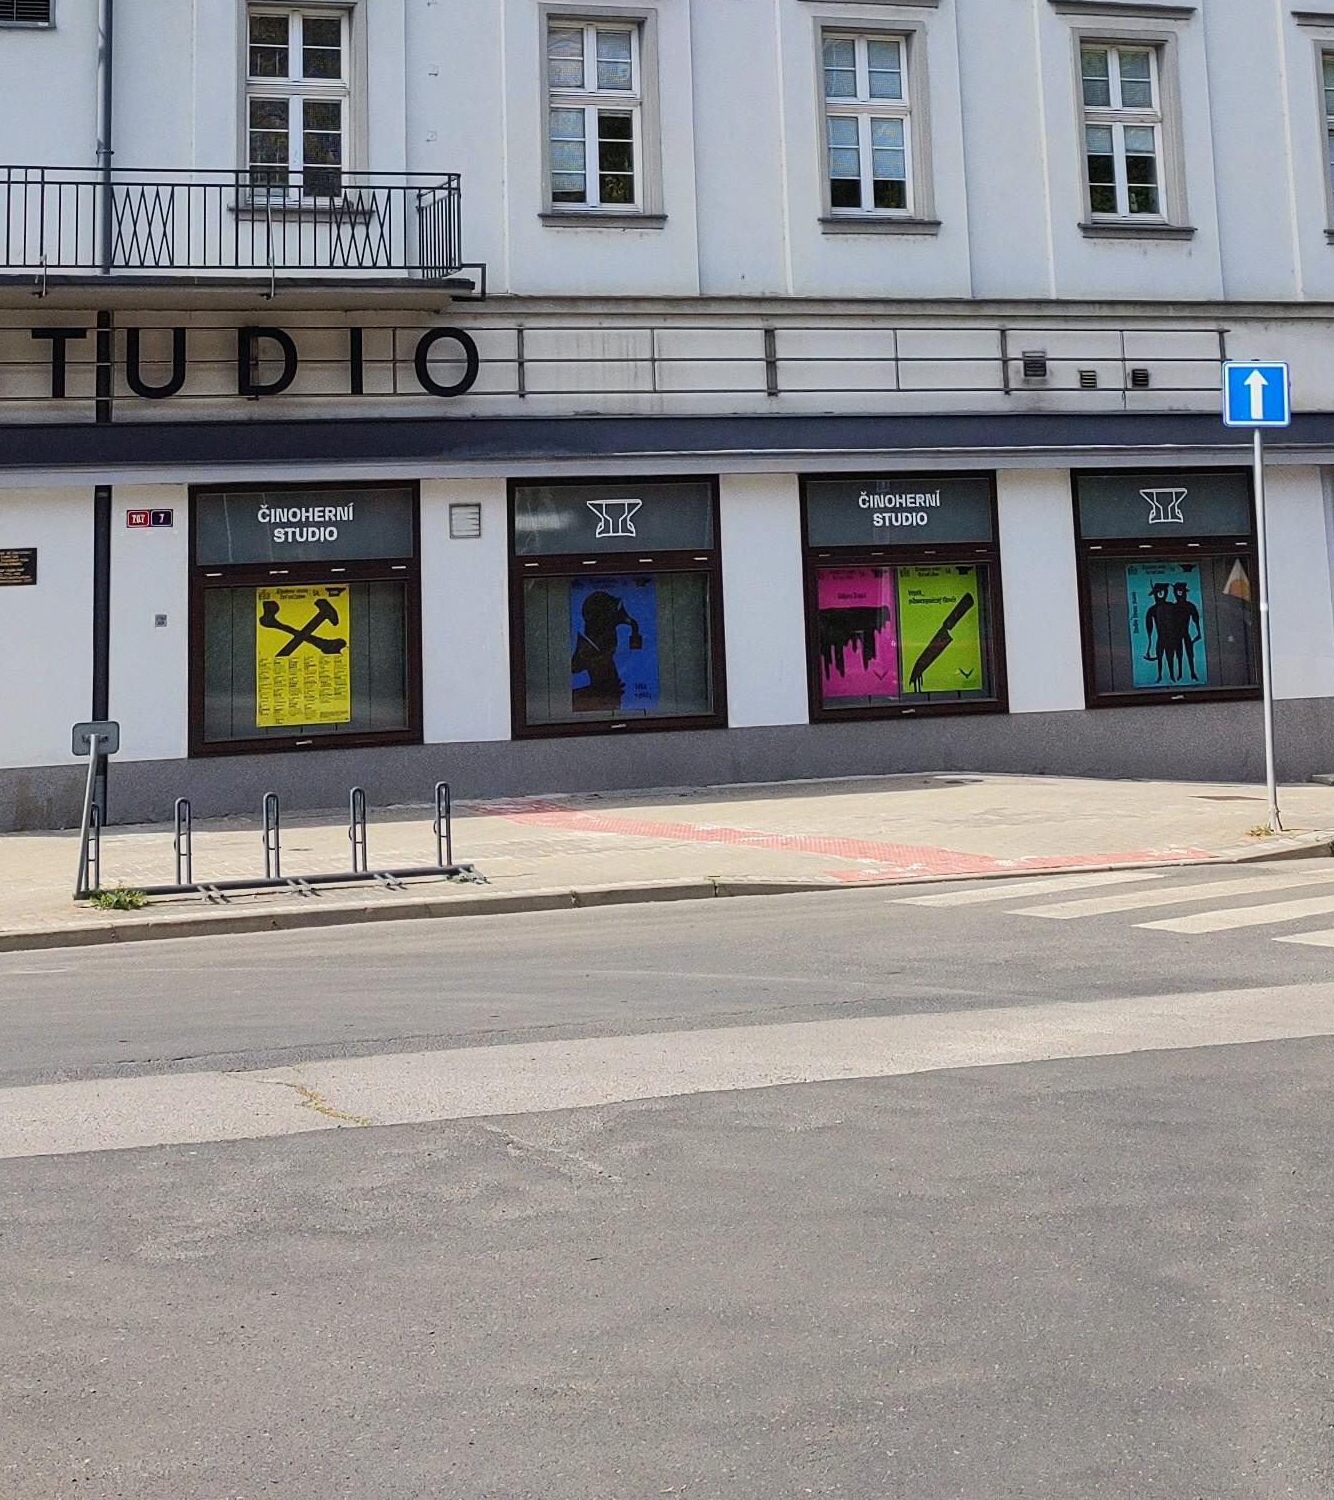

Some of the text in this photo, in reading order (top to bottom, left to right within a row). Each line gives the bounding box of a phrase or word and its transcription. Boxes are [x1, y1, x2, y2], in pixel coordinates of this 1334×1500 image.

[858, 489, 940, 508] ČINOHERNÍ
[257, 502, 354, 523] ČINOHERNÍ
[873, 511, 928, 527] STUDIO
[273, 526, 338, 543] STUDIO
